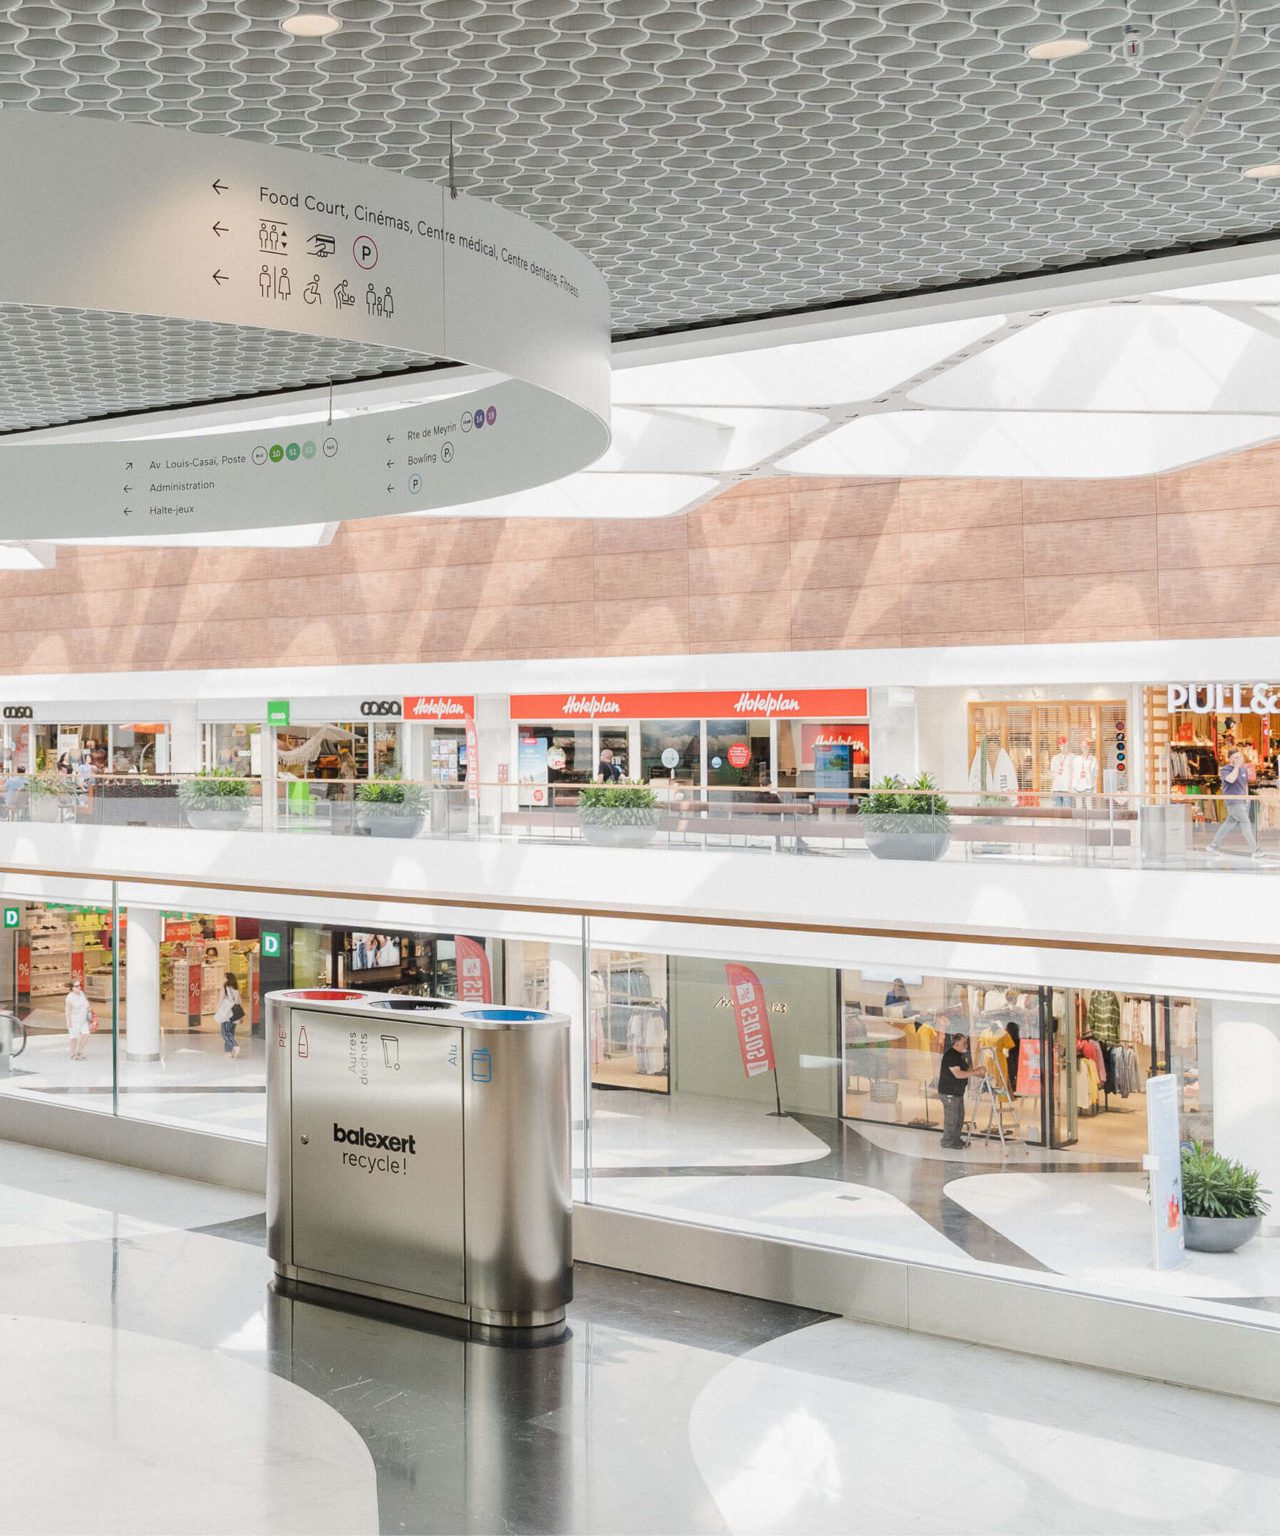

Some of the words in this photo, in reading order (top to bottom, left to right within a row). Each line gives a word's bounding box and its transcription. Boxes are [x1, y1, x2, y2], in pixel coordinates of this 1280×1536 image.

[260, 187, 299, 208] Food
[304, 195, 349, 220] Court,
[354, 204, 413, 235] Cinémas,
[417, 220, 456, 244] Centre
[459, 236, 499, 261] médical,
[501, 247, 529, 271] Centre
[530, 261, 559, 288] dentaire,
[407, 430, 420, 441] Rte
[422, 428, 432, 438] de
[433, 423, 457, 436] Meyrin
[221, 455, 247, 465] Poste
[407, 453, 437, 466] Bowling
[149, 480, 215, 492] Administration
[149, 504, 195, 516] Halte-jeux
[412, 697, 465, 720] Hotelplan
[562, 695, 621, 718] Hotelplan
[734, 692, 800, 717] Hotelplan
[6, 910, 18, 925] D
[264, 935, 278, 953] D
[278, 1023, 287, 1048] PET
[348, 1031, 357, 1074] Autres
[448, 1044, 458, 1067] Alu
[333, 1122, 416, 1155] balexert
